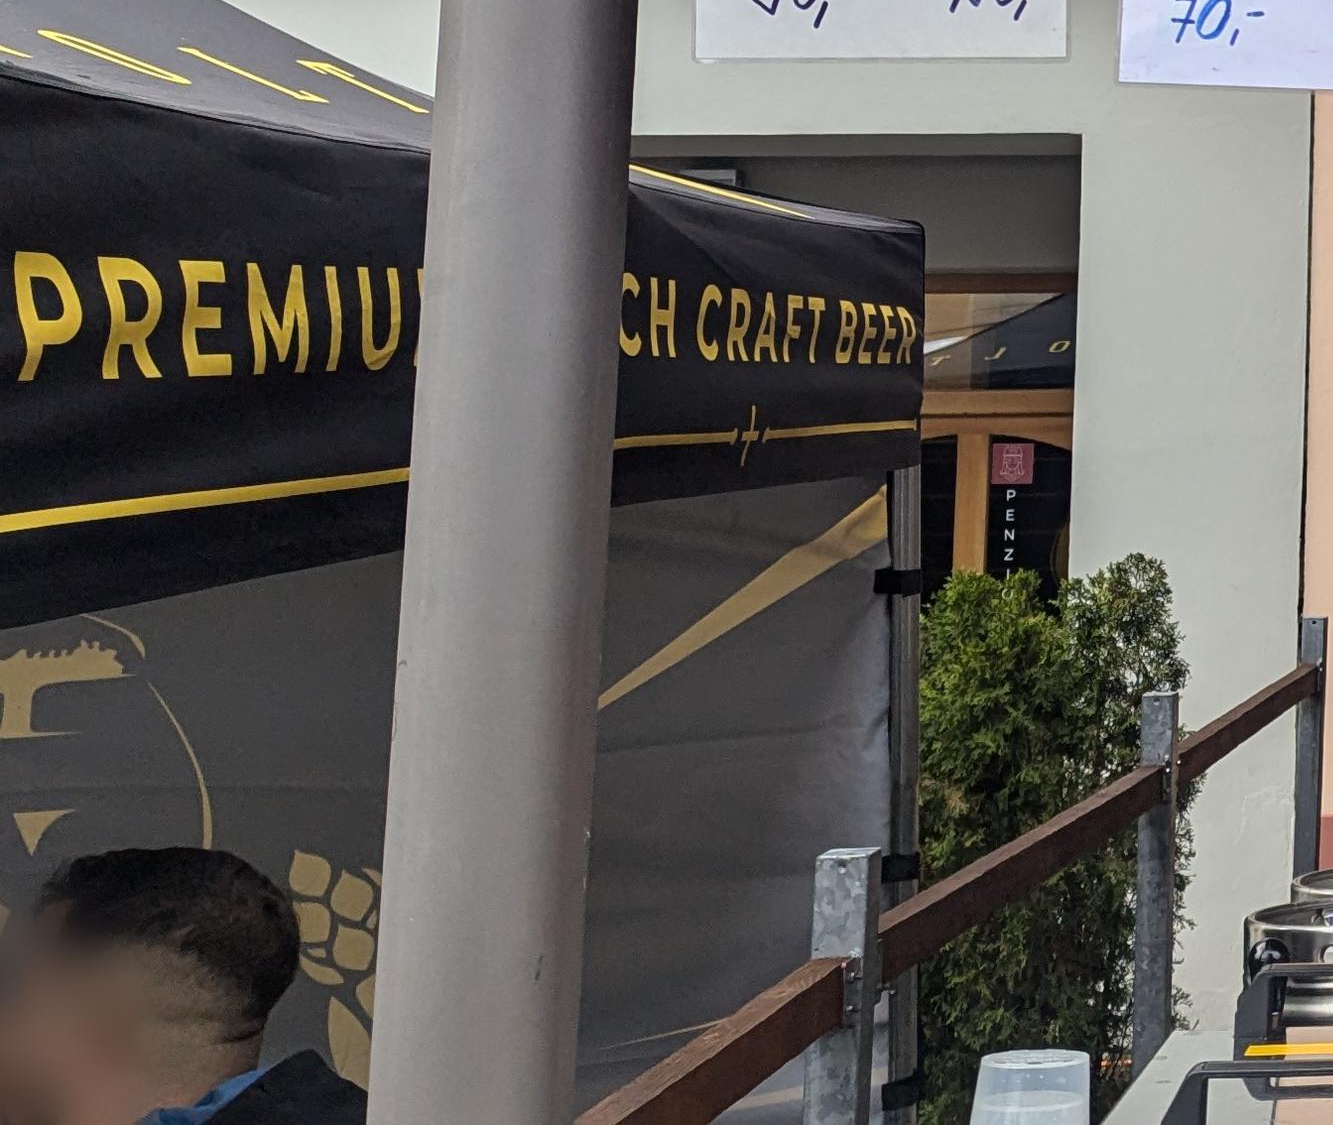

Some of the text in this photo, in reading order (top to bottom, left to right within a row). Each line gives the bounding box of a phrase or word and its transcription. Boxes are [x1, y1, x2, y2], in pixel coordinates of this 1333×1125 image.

[13, 251, 425, 382] PREMIU
[697, 283, 826, 364] CRAFT
[834, 298, 918, 365] BEER
